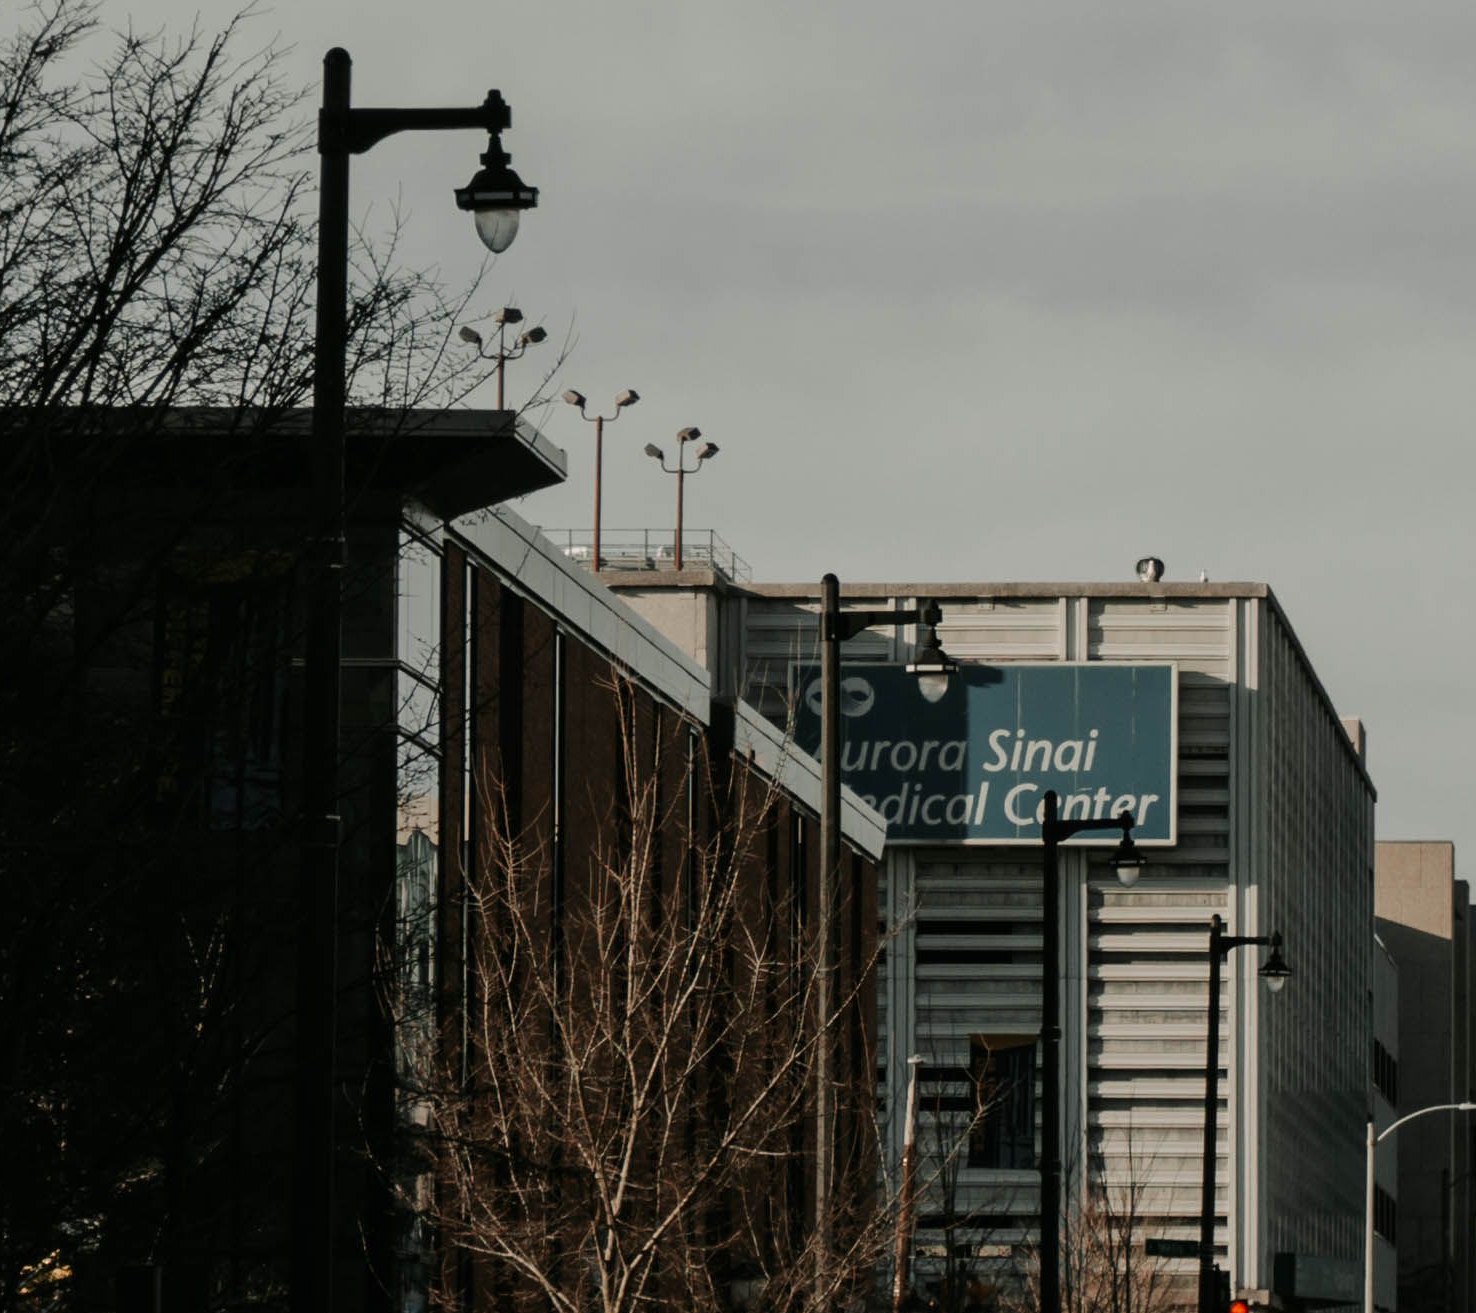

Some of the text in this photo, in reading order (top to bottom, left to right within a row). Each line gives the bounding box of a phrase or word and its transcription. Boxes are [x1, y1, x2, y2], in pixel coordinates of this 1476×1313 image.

[812, 728, 1099, 773] urora Sinai
[859, 781, 990, 825] dical
